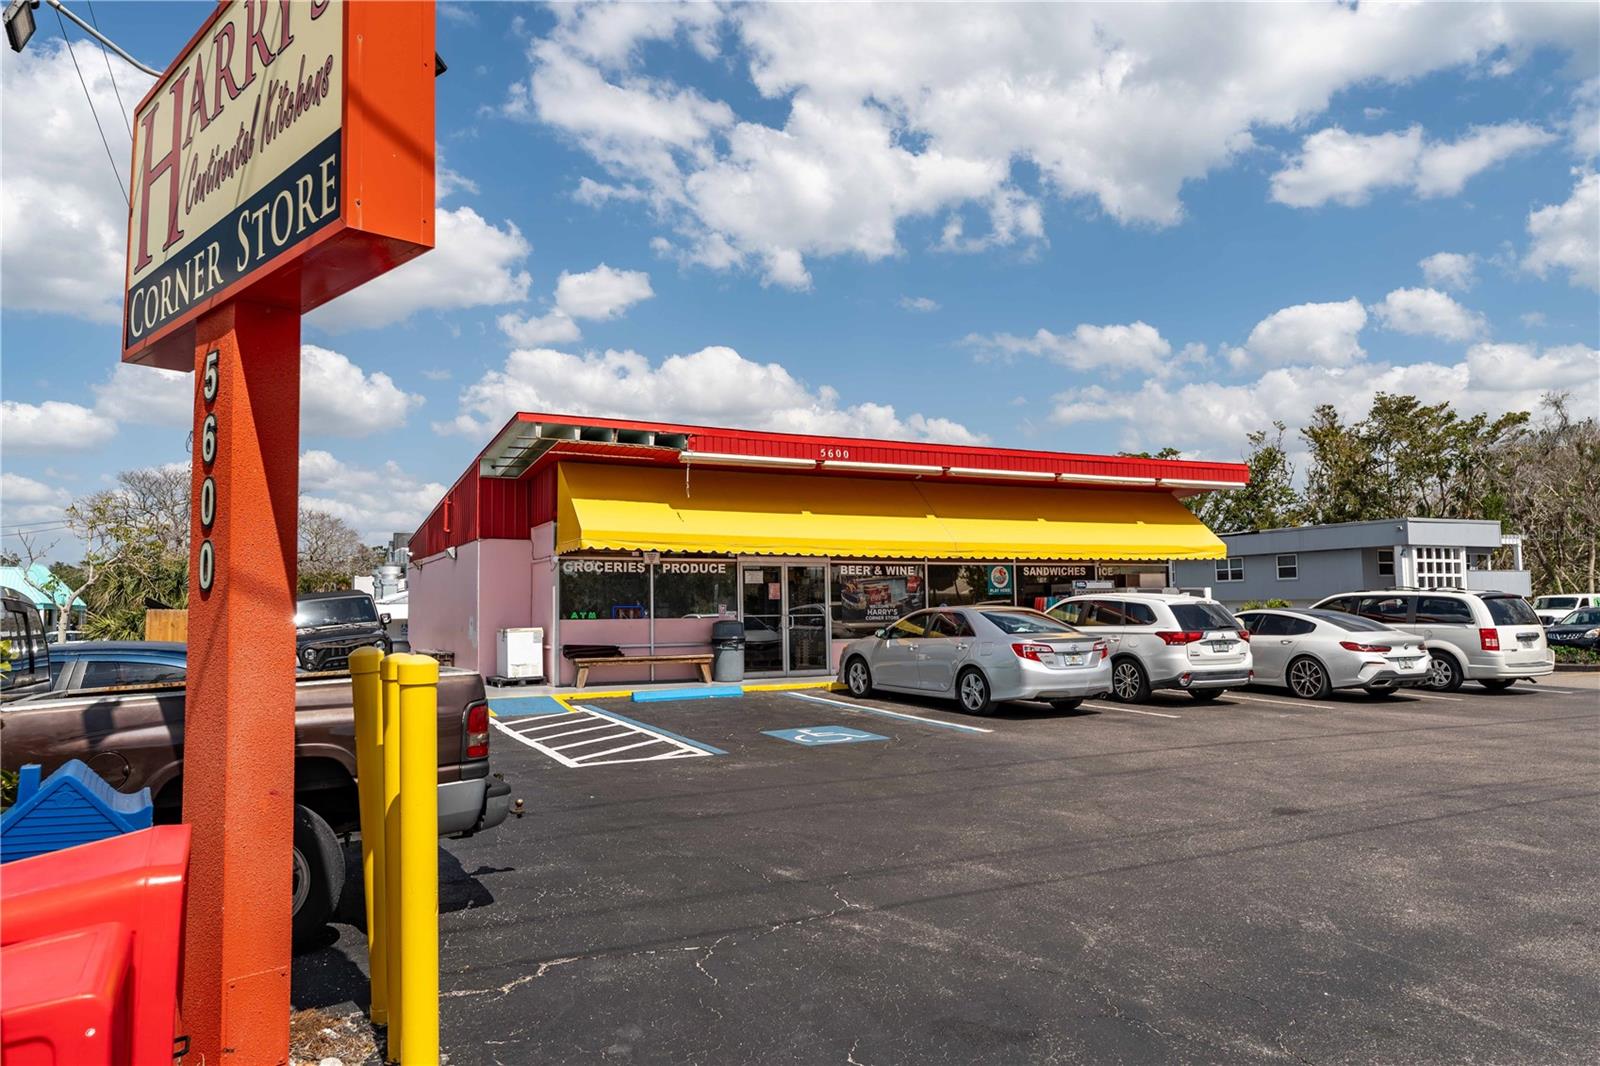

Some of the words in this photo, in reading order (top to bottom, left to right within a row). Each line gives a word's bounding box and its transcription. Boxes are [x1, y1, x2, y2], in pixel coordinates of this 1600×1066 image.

[134, 0, 329, 275] HARRY
[186, 94, 261, 216] Continental
[261, 54, 334, 153] Kitchens
[130, 241, 224, 338] CORNER
[236, 153, 337, 272] STORE
[820, 448, 849, 459] 5600
[199, 349, 219, 592] 5600
[562, 561, 646, 574] GROCERIES
[662, 563, 727, 574] PRODUCE
[840, 565, 871, 575] BEER
[873, 566, 882, 575] &
[885, 565, 915, 575] WINE
[1023, 567, 1086, 576] SANDWICHES
[1098, 567, 1114, 576] ICE
